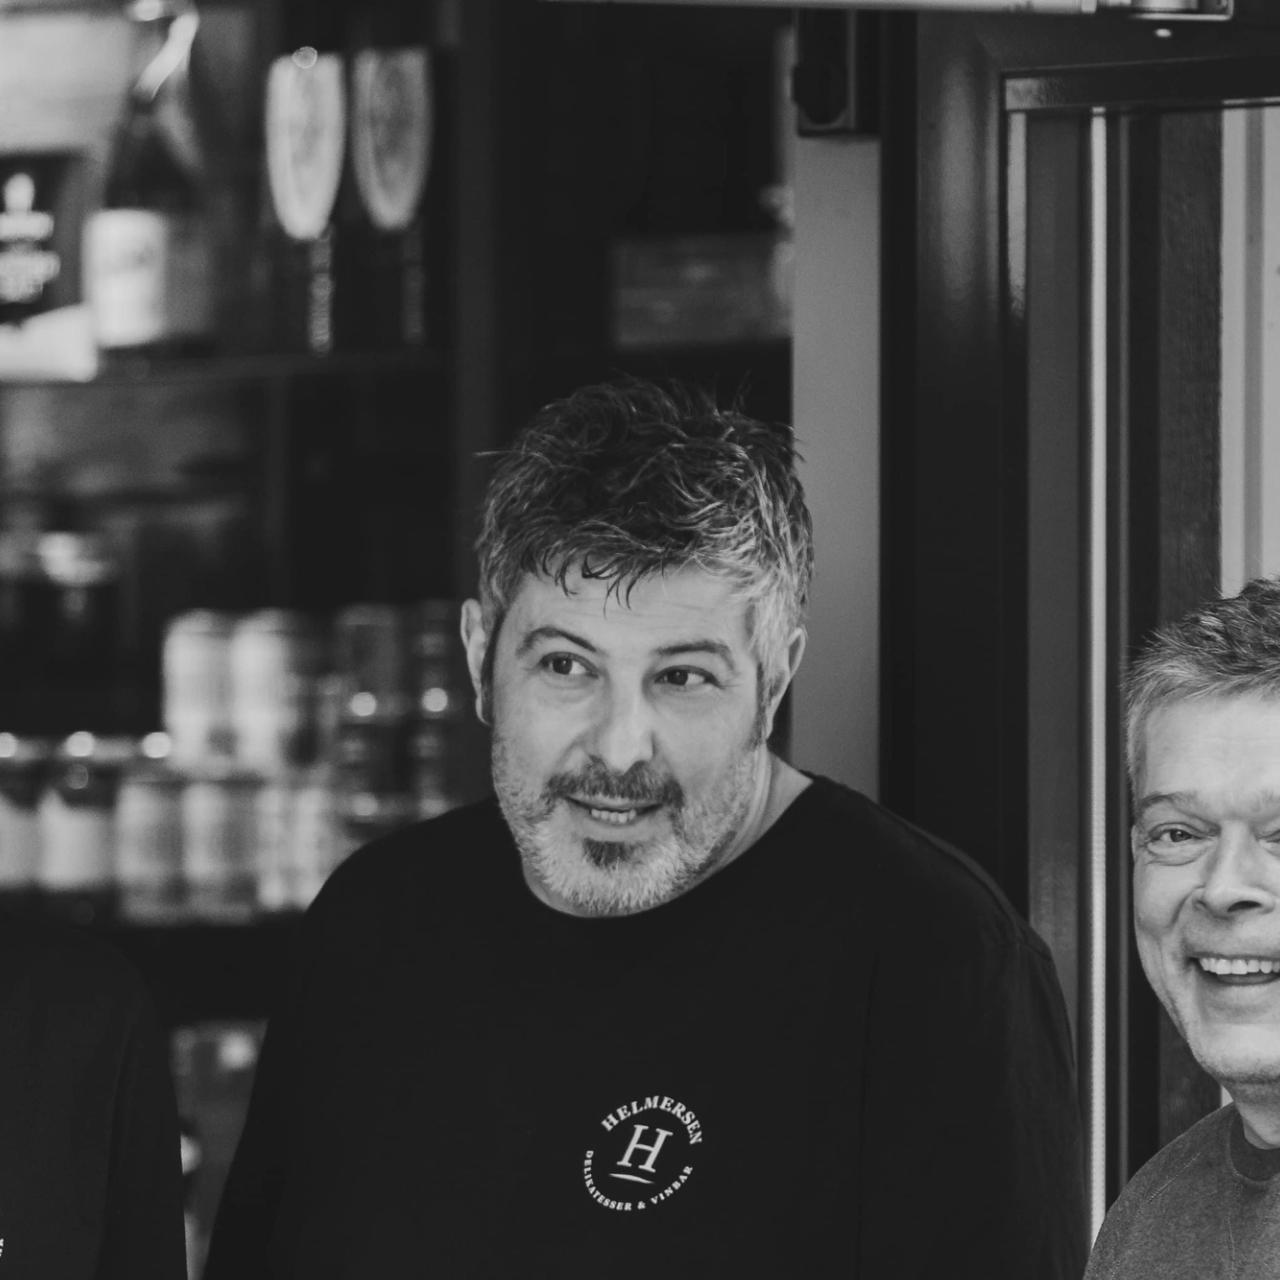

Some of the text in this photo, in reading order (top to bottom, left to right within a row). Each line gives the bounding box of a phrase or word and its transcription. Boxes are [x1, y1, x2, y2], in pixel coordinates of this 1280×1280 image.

[601, 1095, 702, 1144] HELMERSEN
[617, 1124, 673, 1173] H
[584, 1150, 632, 1211] DELIKATESSER
[650, 1165, 693, 1205] VINBAR
